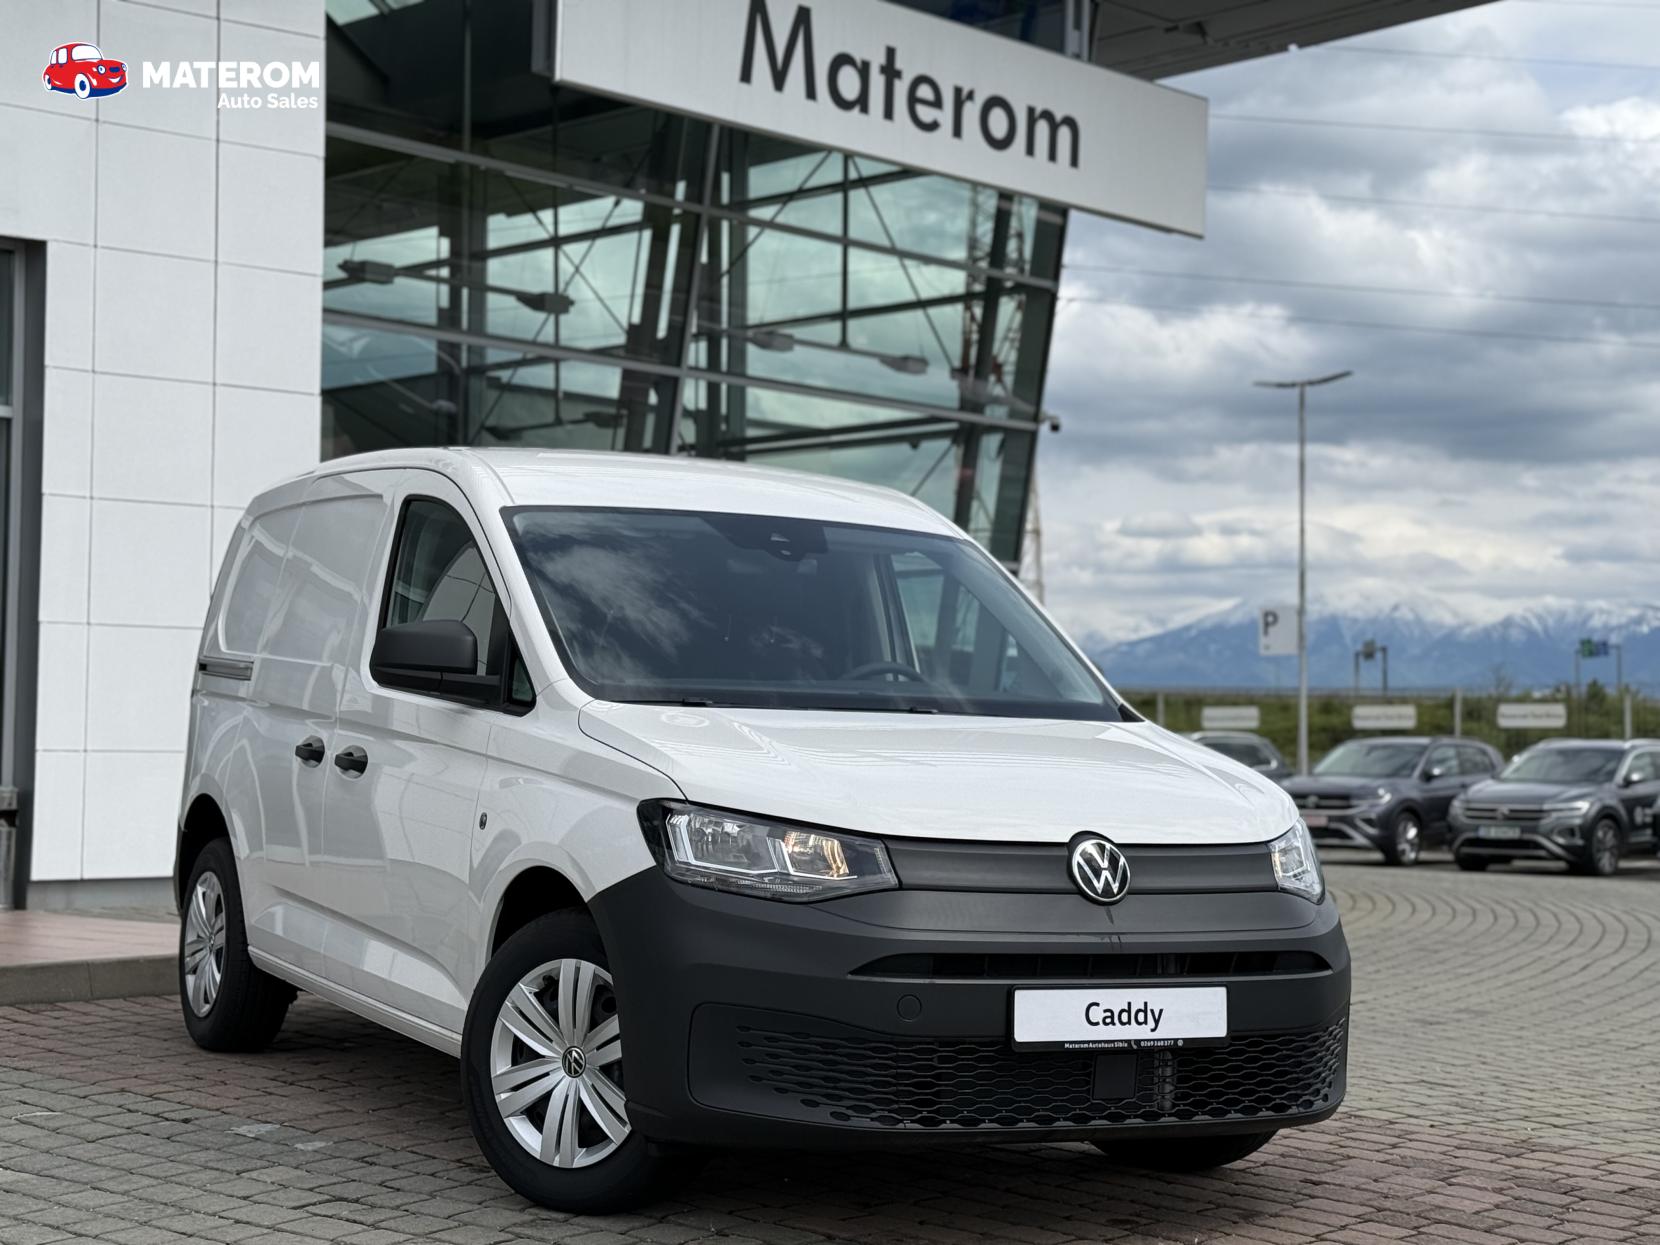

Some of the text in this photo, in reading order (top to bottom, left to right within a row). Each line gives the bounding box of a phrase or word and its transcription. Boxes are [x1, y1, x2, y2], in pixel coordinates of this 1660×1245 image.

[739, 0, 1081, 169] Materom
[1263, 610, 1279, 637] P
[1084, 1001, 1164, 1033] Caddy
